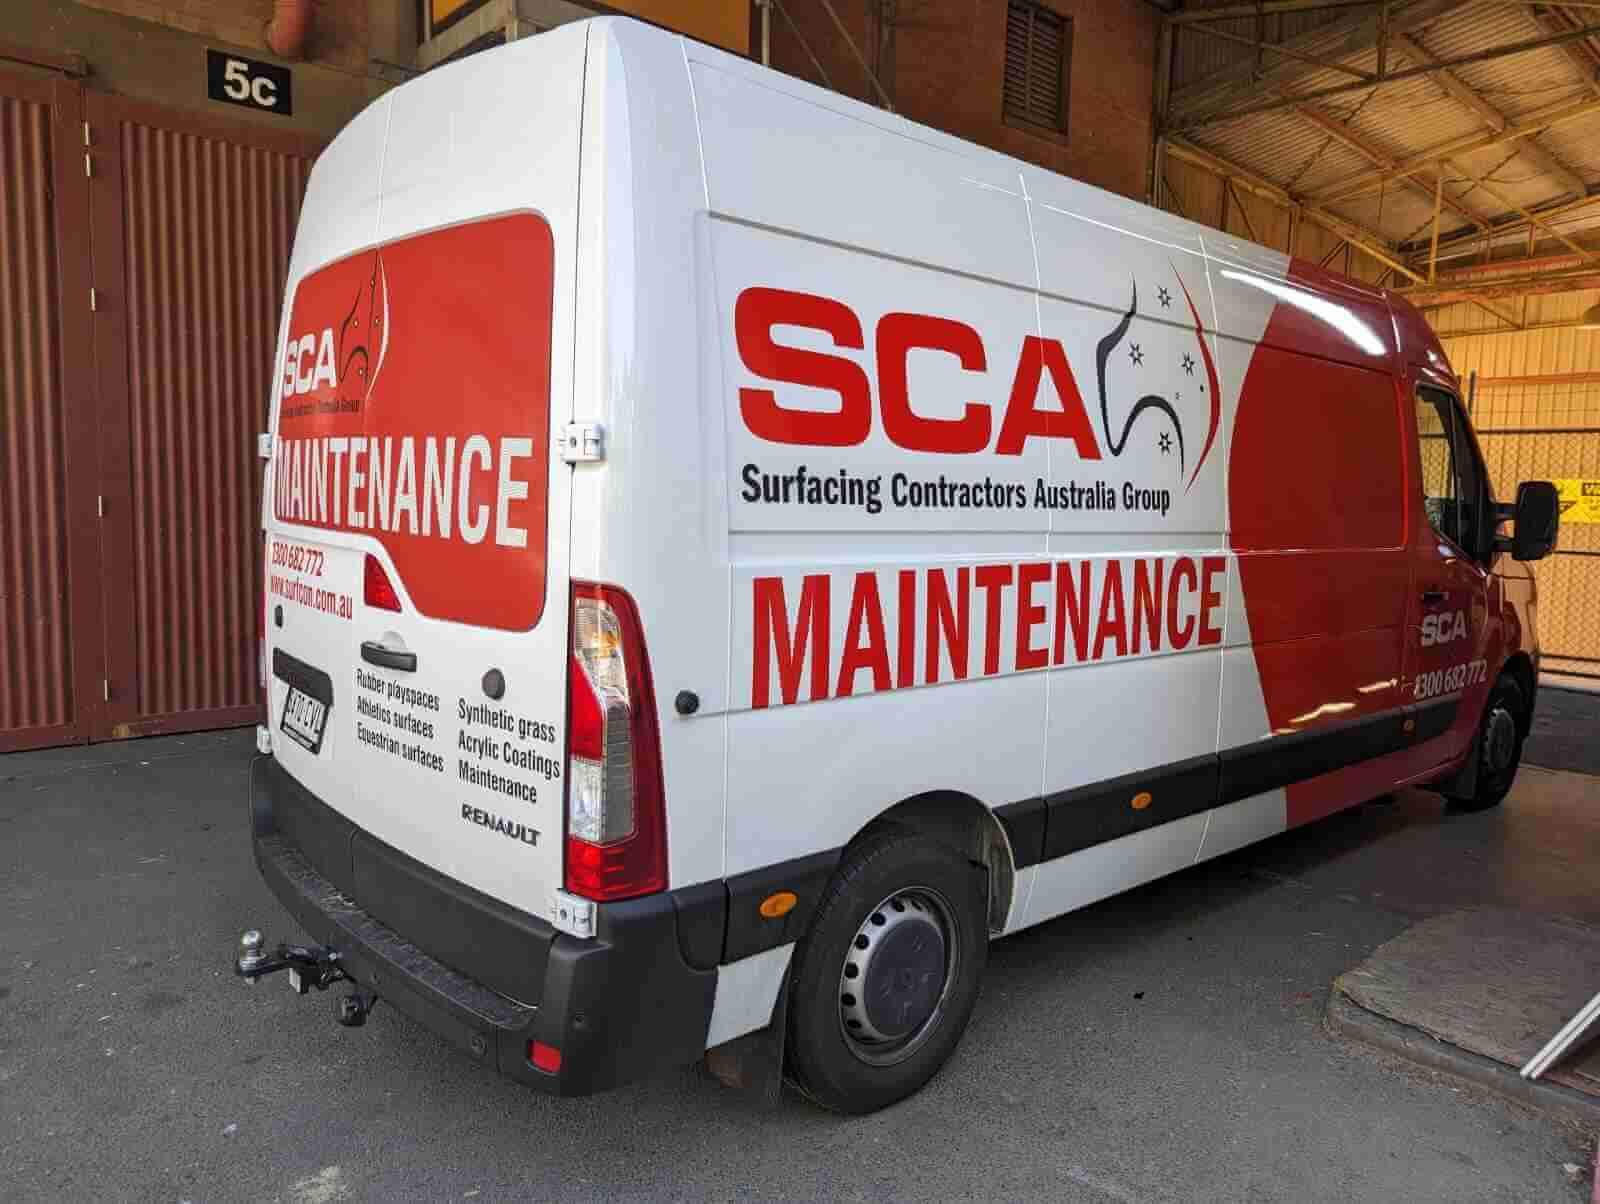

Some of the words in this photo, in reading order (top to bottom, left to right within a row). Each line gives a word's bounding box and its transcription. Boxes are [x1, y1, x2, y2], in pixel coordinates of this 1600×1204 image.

[283, 328, 337, 399] SCA
[735, 287, 1102, 460] SCA
[275, 434, 533, 548] MAINTENANCE
[741, 463, 882, 514] Surfacing
[891, 472, 1027, 508] Contractors
[1034, 478, 1116, 510] Australia
[1123, 481, 1170, 517] Group
[288, 545, 305, 571] 682
[304, 548, 324, 576] 772
[751, 556, 1226, 709] MAINTENANCE
[1421, 608, 1467, 647] SCA
[357, 668, 385, 694] Rubber
[387, 680, 440, 712] playspaces
[1444, 663, 1466, 692] 682
[357, 695, 391, 725] Athletics
[393, 711, 433, 739] surfaces
[458, 697, 514, 732] Synthetic
[518, 717, 556, 743] grass
[357, 721, 400, 756] Equestrian
[402, 743, 444, 772] surfaces
[458, 729, 499, 760] Acrylic
[503, 741, 560, 780] Coatings
[458, 759, 537, 804] Maintenance
[461, 803, 542, 846] RENAULT
